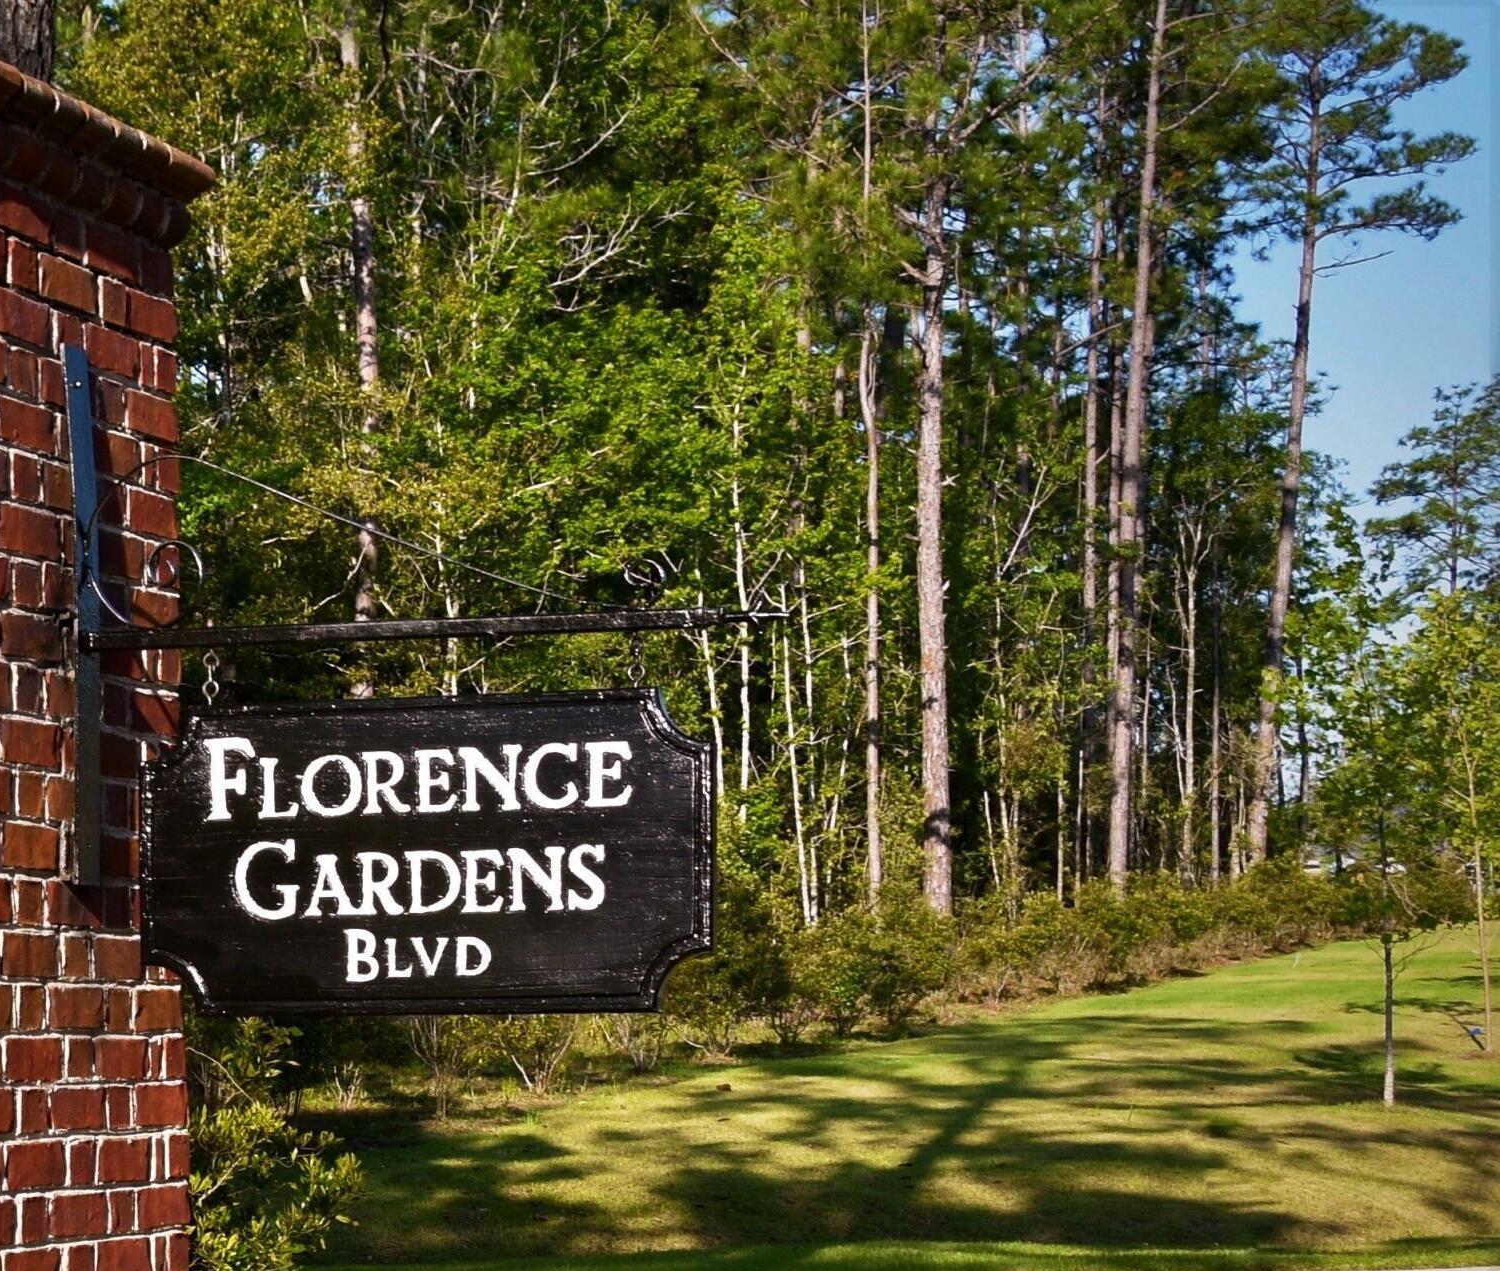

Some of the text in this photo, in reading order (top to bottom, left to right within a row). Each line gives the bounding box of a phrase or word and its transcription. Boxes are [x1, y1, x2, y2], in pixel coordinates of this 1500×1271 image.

[202, 736, 634, 822] FLORENCE
[234, 839, 605, 921] GARDENS
[344, 928, 492, 983] BLVD
